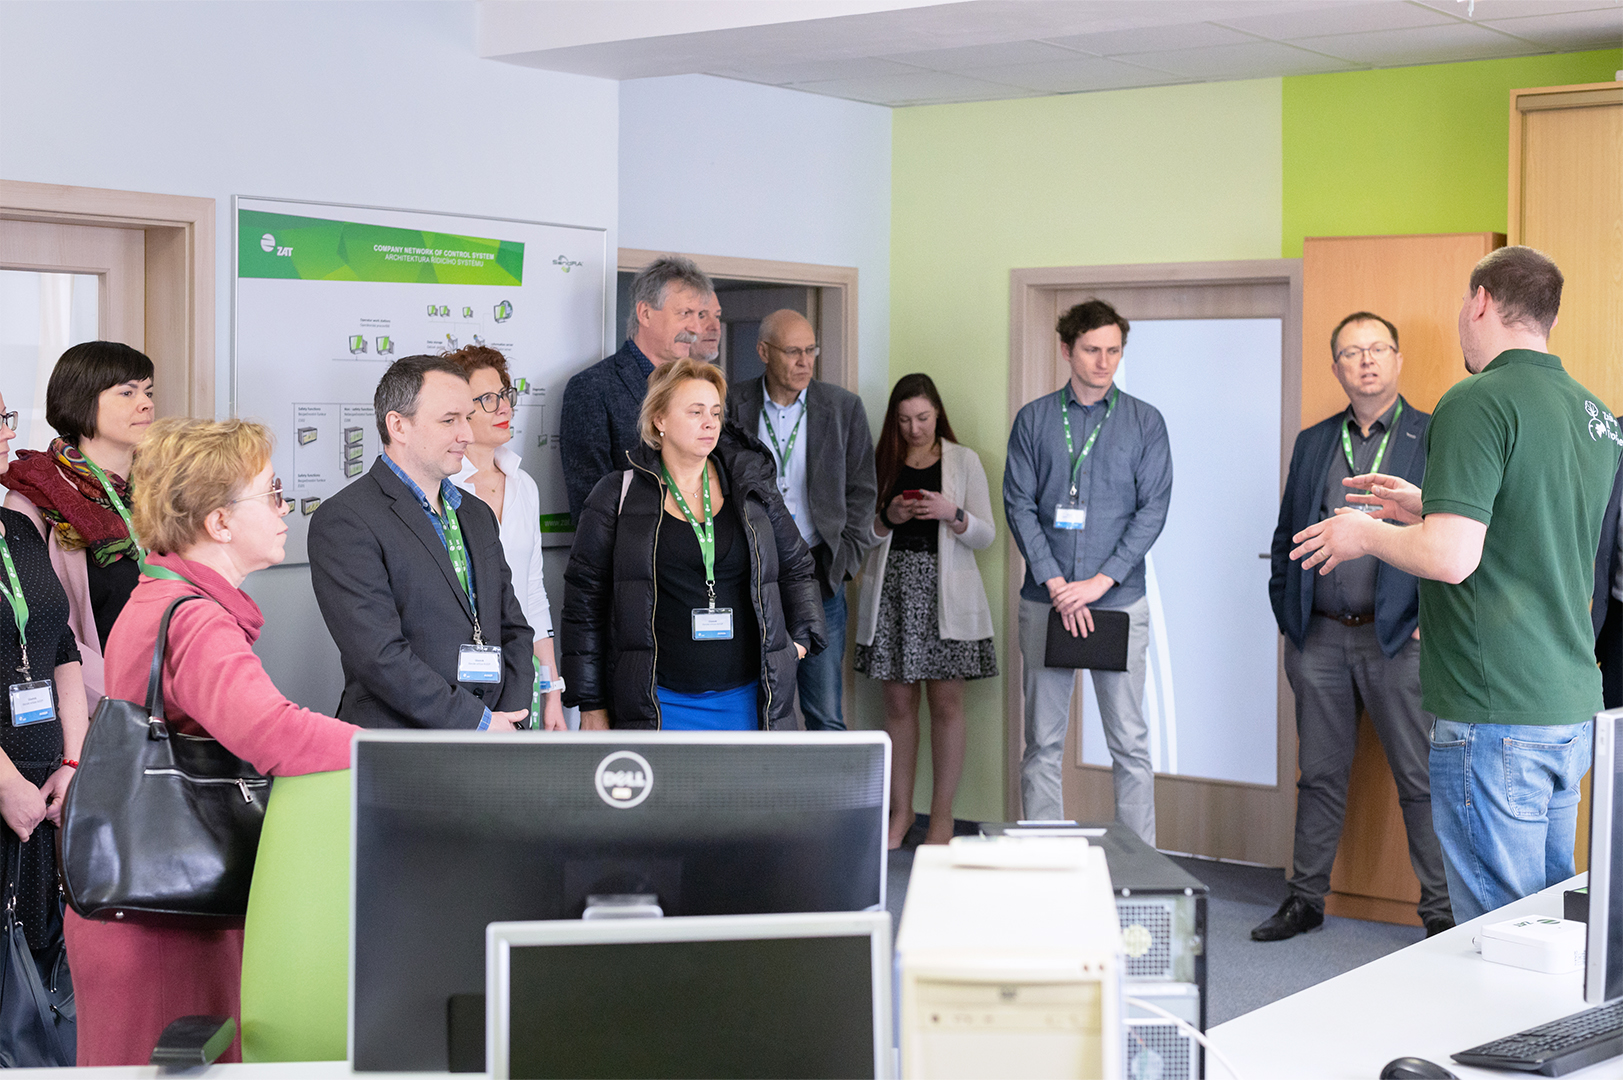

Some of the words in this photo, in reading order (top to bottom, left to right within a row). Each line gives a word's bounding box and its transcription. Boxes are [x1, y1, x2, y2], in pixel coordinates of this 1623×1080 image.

[276, 246, 294, 257] ZAT
[373, 244, 404, 254] COMPANY
[403, 246, 434, 256] NETWORK
[443, 250, 471, 258] CONTROL
[471, 252, 495, 260] SYSTEM
[385, 253, 430, 263] ARCHITEKTURA
[602, 769, 646, 788] DELL
